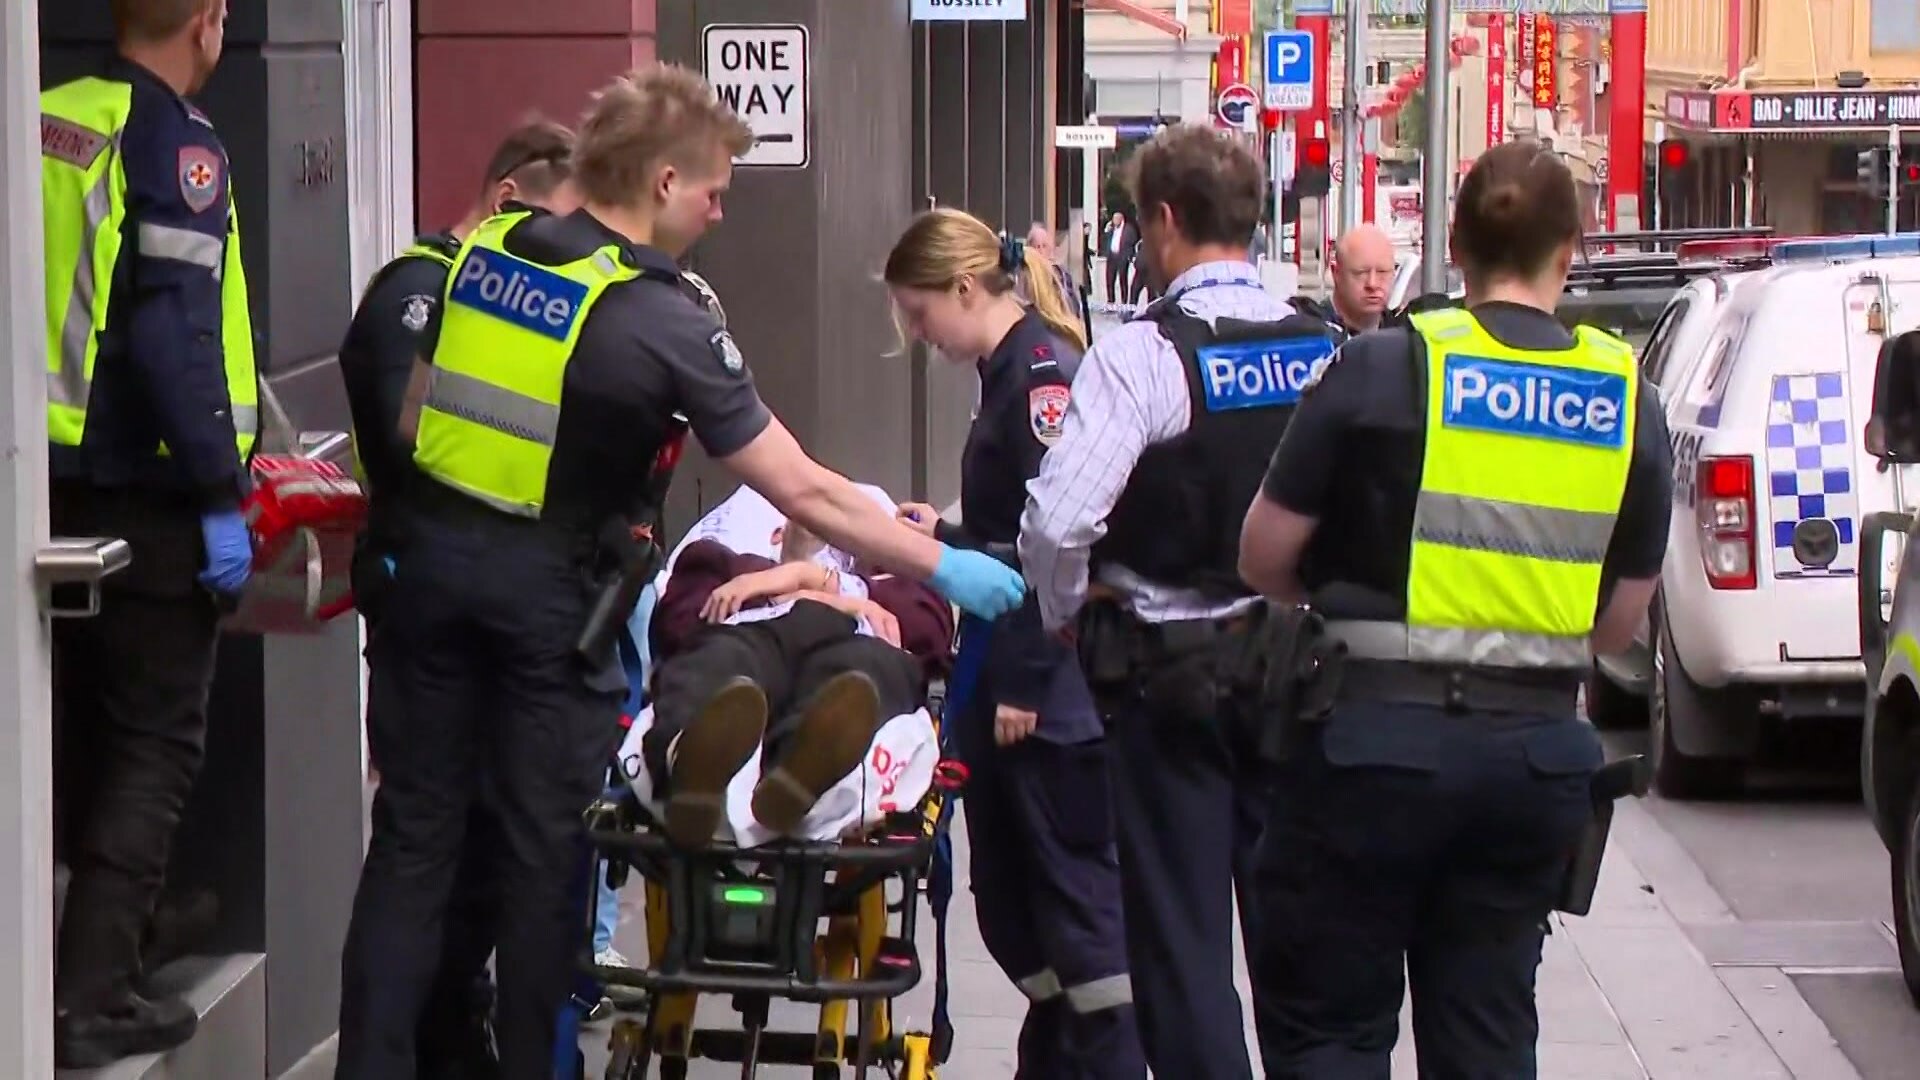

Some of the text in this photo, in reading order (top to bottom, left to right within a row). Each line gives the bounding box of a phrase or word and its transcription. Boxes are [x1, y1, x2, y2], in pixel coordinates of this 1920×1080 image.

[721, 40, 790, 71] ONE
[1277, 41, 1301, 77] P
[716, 83, 795, 115] WAY
[1753, 97, 1782, 121] BAD
[1794, 96, 1836, 121] BILLIE
[1839, 95, 1876, 120] JEAN
[455, 254, 571, 327] Police
[1452, 368, 1618, 433] Police
